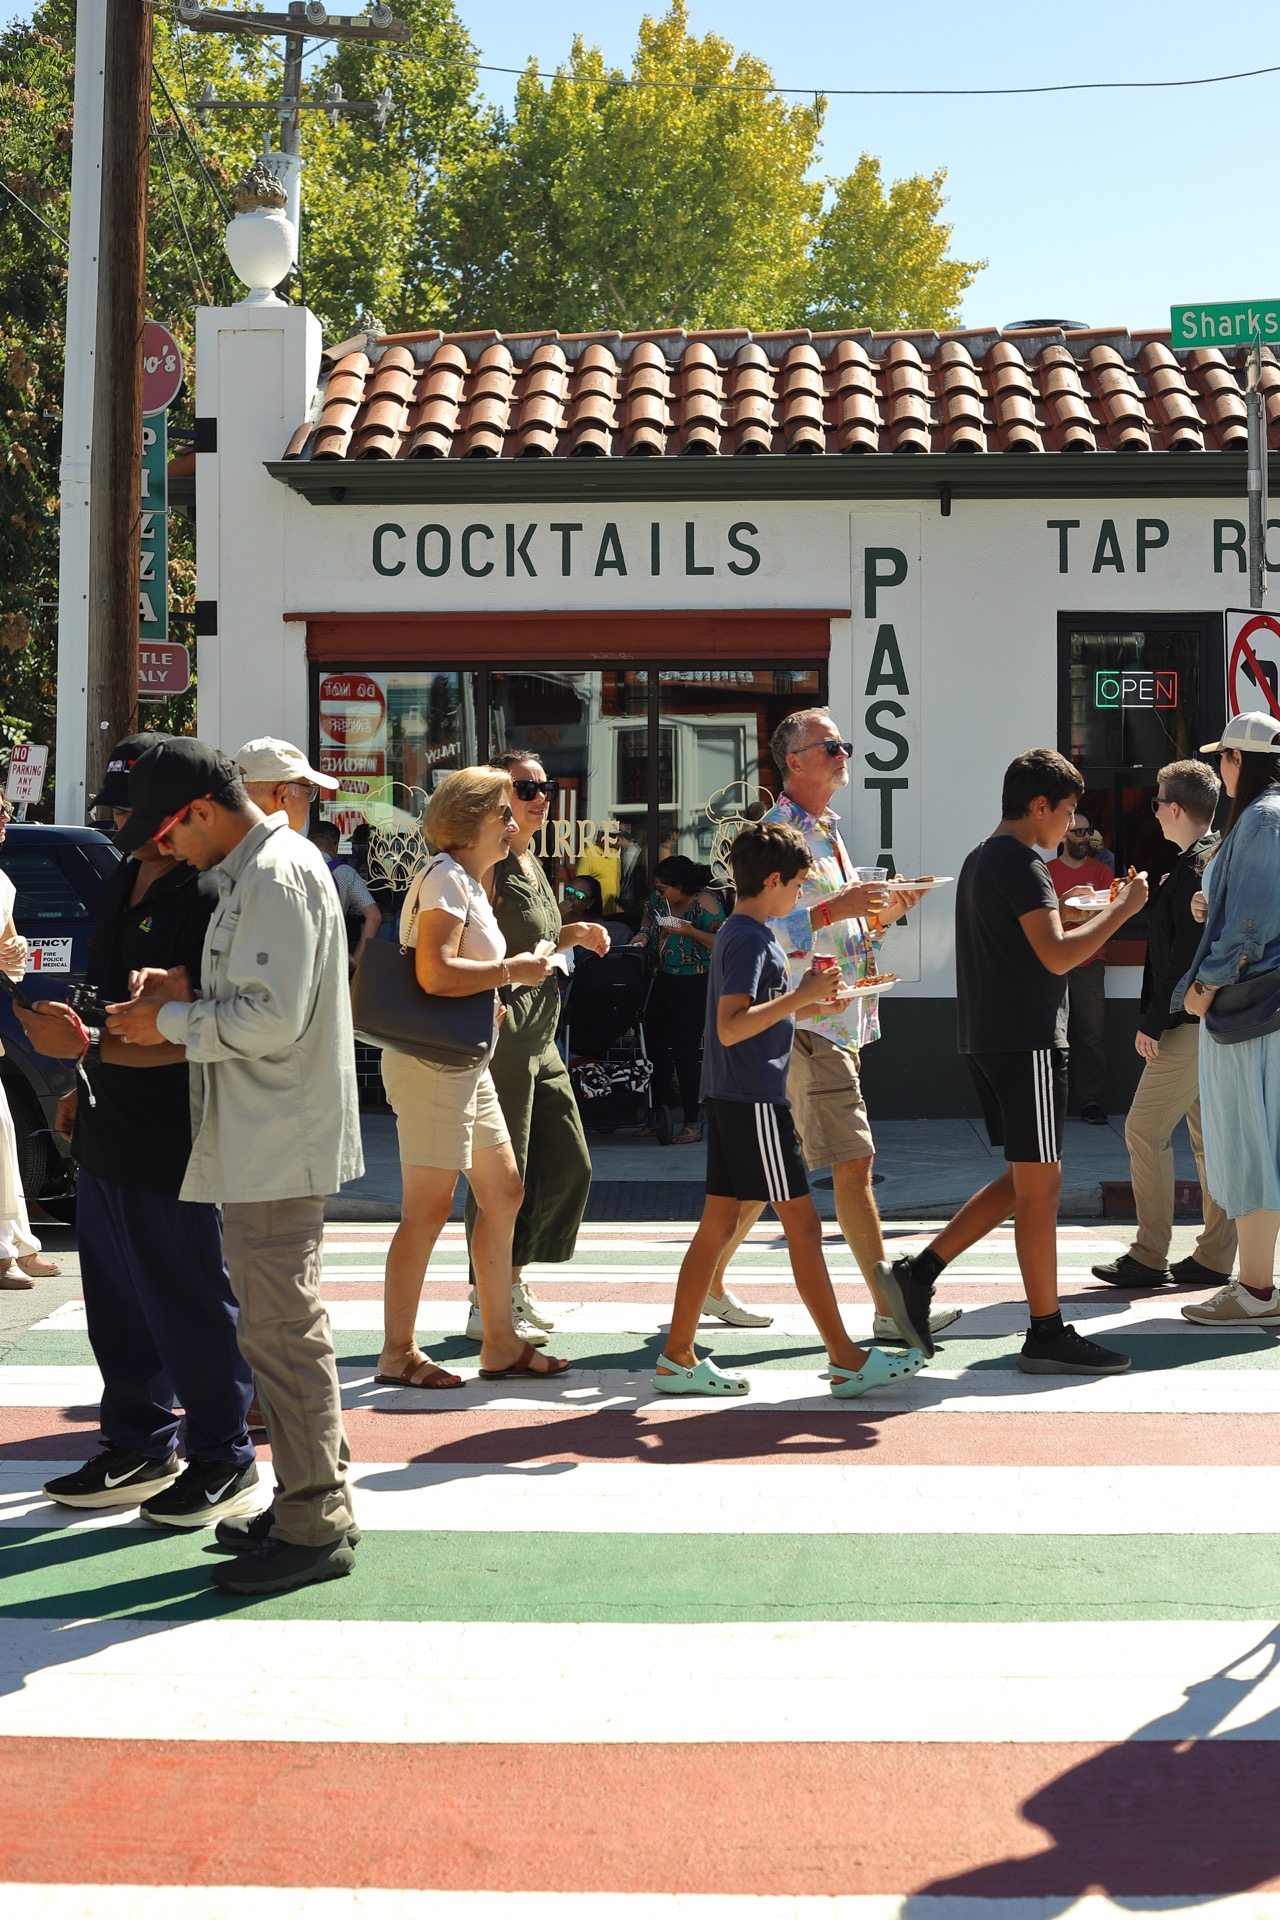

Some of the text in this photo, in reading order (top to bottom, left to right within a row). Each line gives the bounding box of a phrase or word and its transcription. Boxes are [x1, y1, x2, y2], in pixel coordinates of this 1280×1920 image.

[1182, 308, 1278, 339] Sharks
[372, 522, 761, 578] COCKTAILS
[1047, 519, 1170, 573] TAP
[1101, 679, 1173, 700] OPEN
[13, 747, 27, 760] NO
[12, 765, 42, 776] PARKING
[18, 777, 32, 785] ANY
[16, 787, 31, 795] TIME
